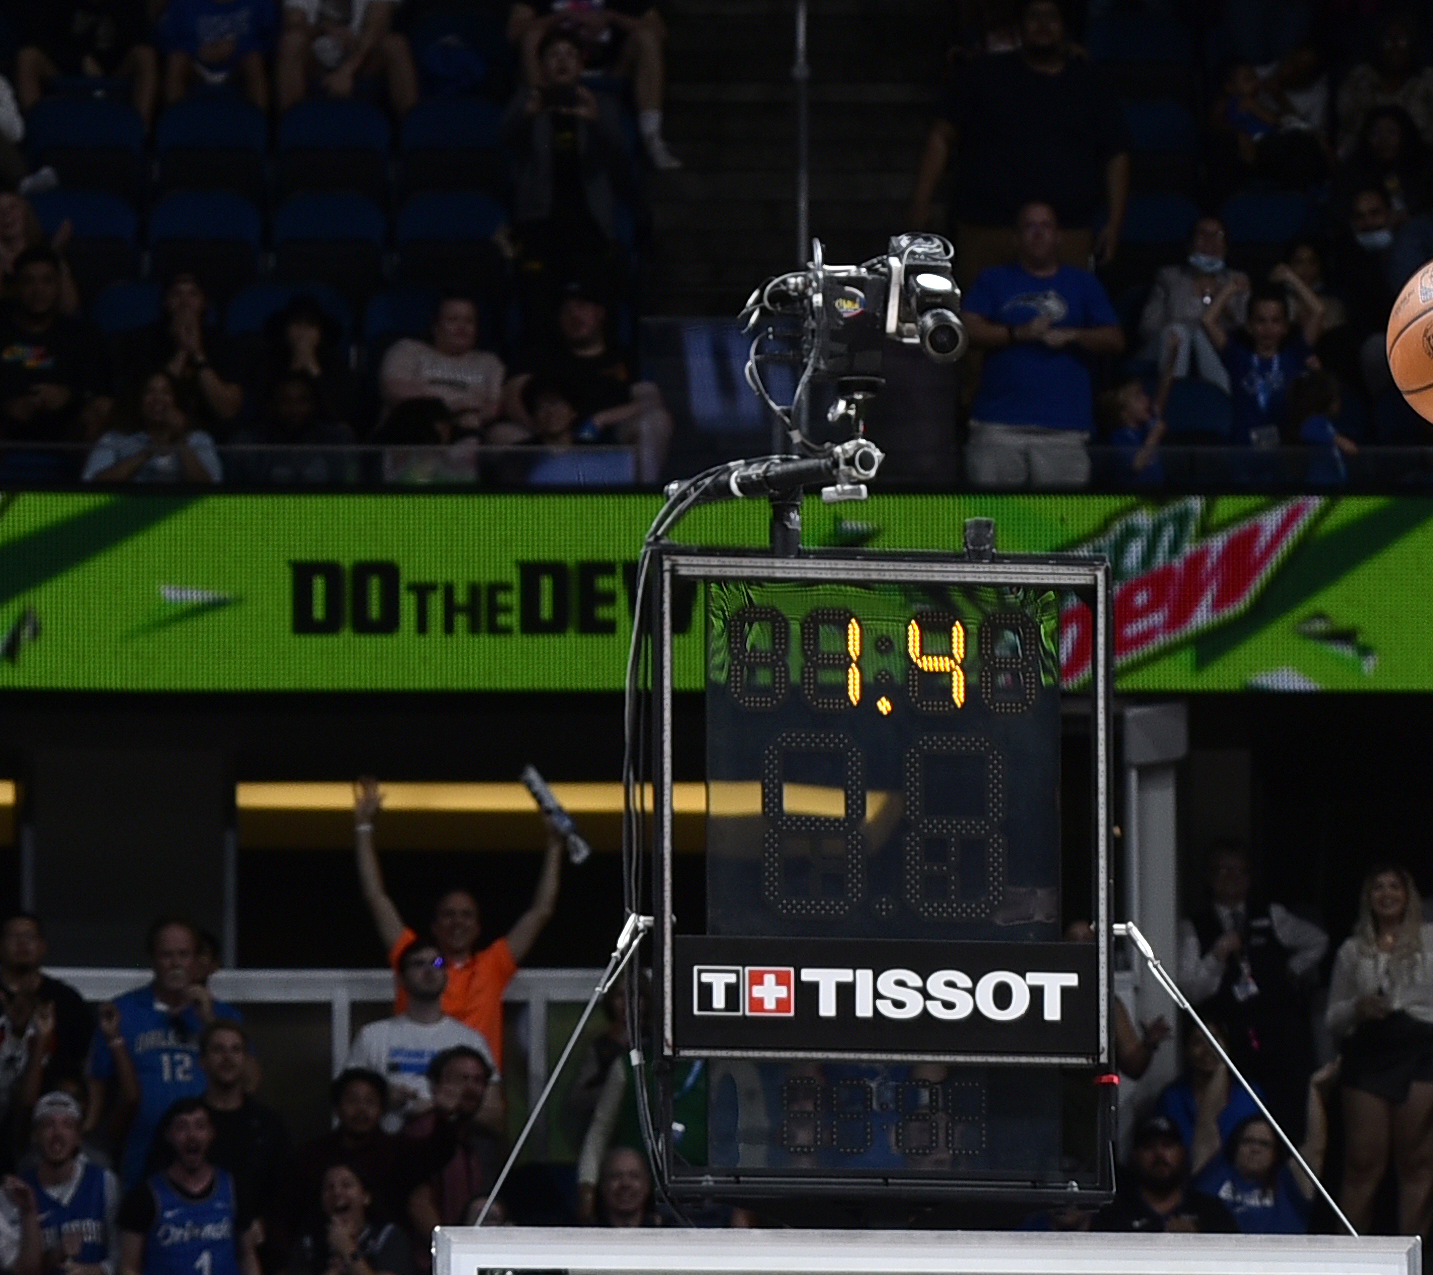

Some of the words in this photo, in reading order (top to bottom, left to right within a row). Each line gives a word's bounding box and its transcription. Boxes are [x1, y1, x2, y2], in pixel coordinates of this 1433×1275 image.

[847, 619, 965, 715] 1.4
[801, 969, 1078, 1021] TISSOT
[161, 1053, 193, 1082] 12
